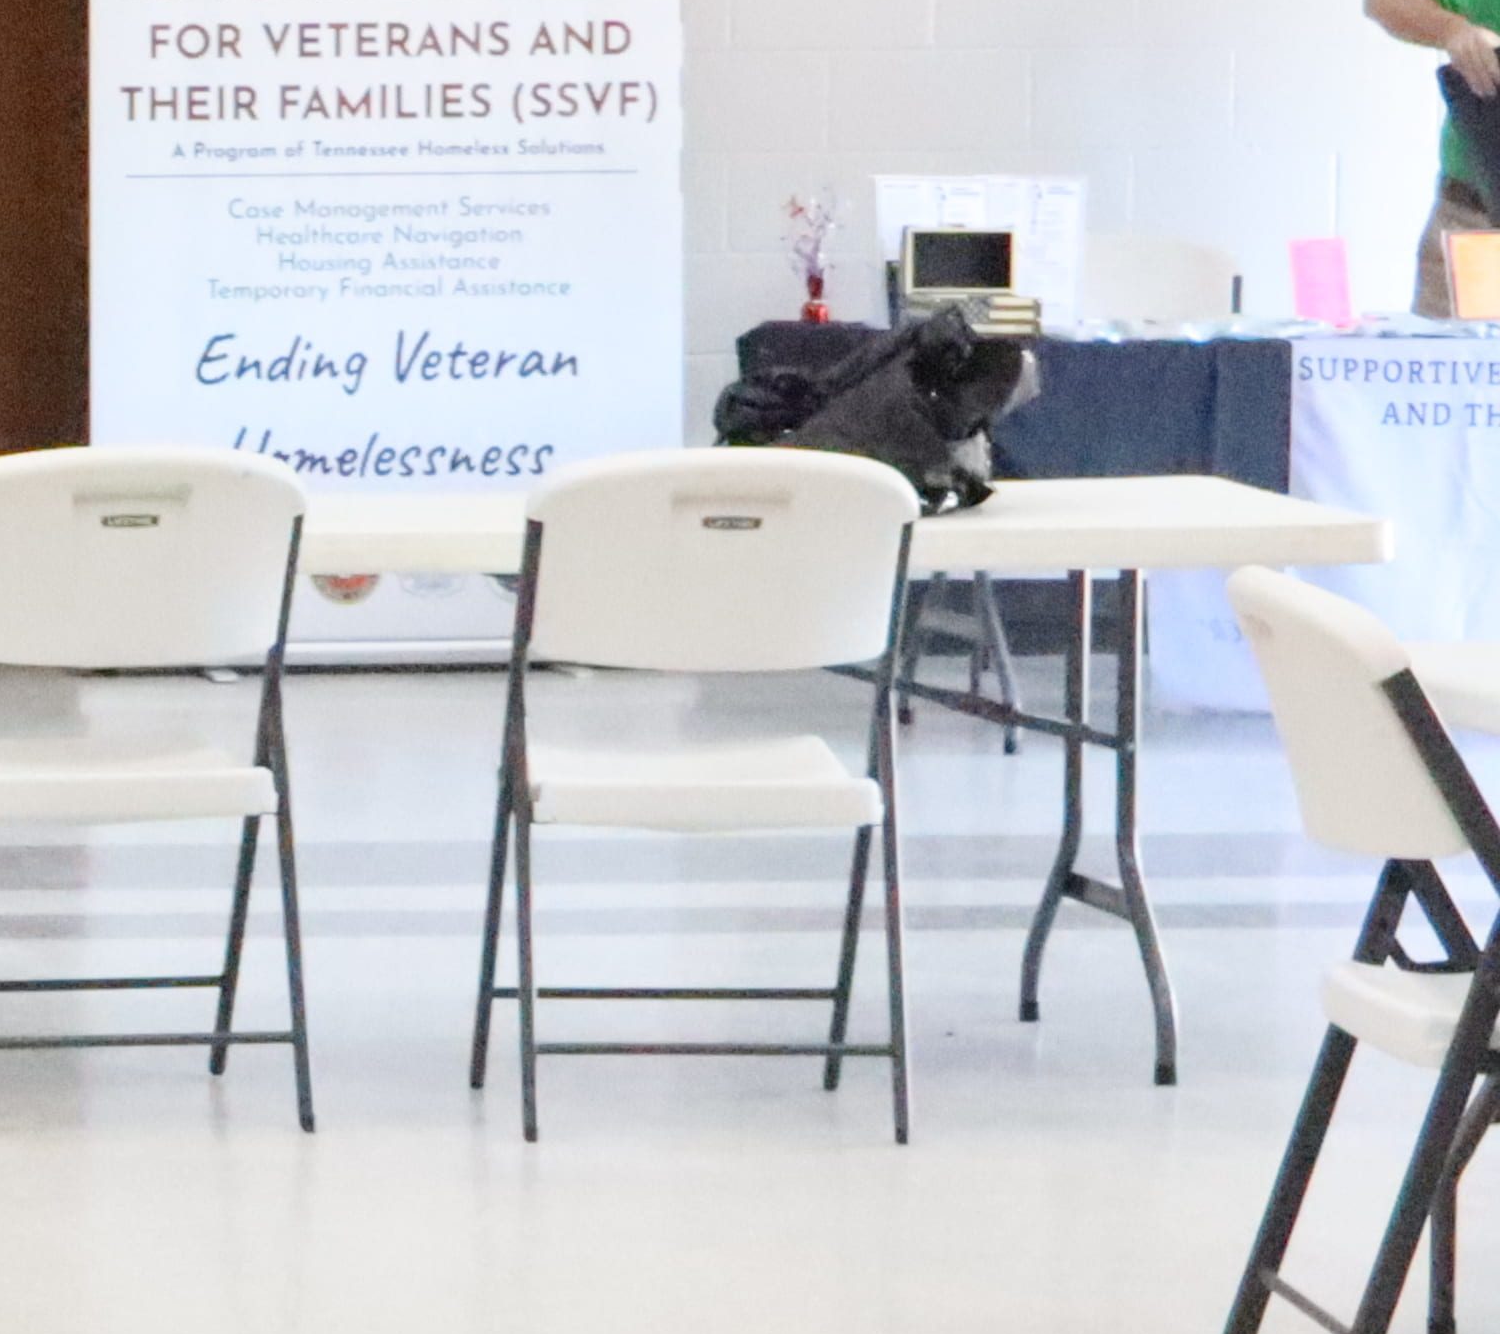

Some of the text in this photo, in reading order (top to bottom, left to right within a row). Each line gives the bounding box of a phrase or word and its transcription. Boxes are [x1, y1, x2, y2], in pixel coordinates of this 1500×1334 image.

[148, 20, 633, 59] FOR VETERANS AND
[120, 81, 660, 124] THEIR FAMILIES (SSVF)
[171, 138, 605, 162] A Program of Tennessee Homeless Solutions
[227, 196, 552, 225] Case Management Services
[255, 224, 522, 249] Healthcare Navigation
[277, 251, 500, 277] Housing Assistance
[207, 275, 571, 305] Temporary Financial Assistance
[196, 329, 580, 395] Ending Veteran
[1297, 356, 1500, 386] SUPPORTIVE
[1380, 401, 1451, 426] AND
